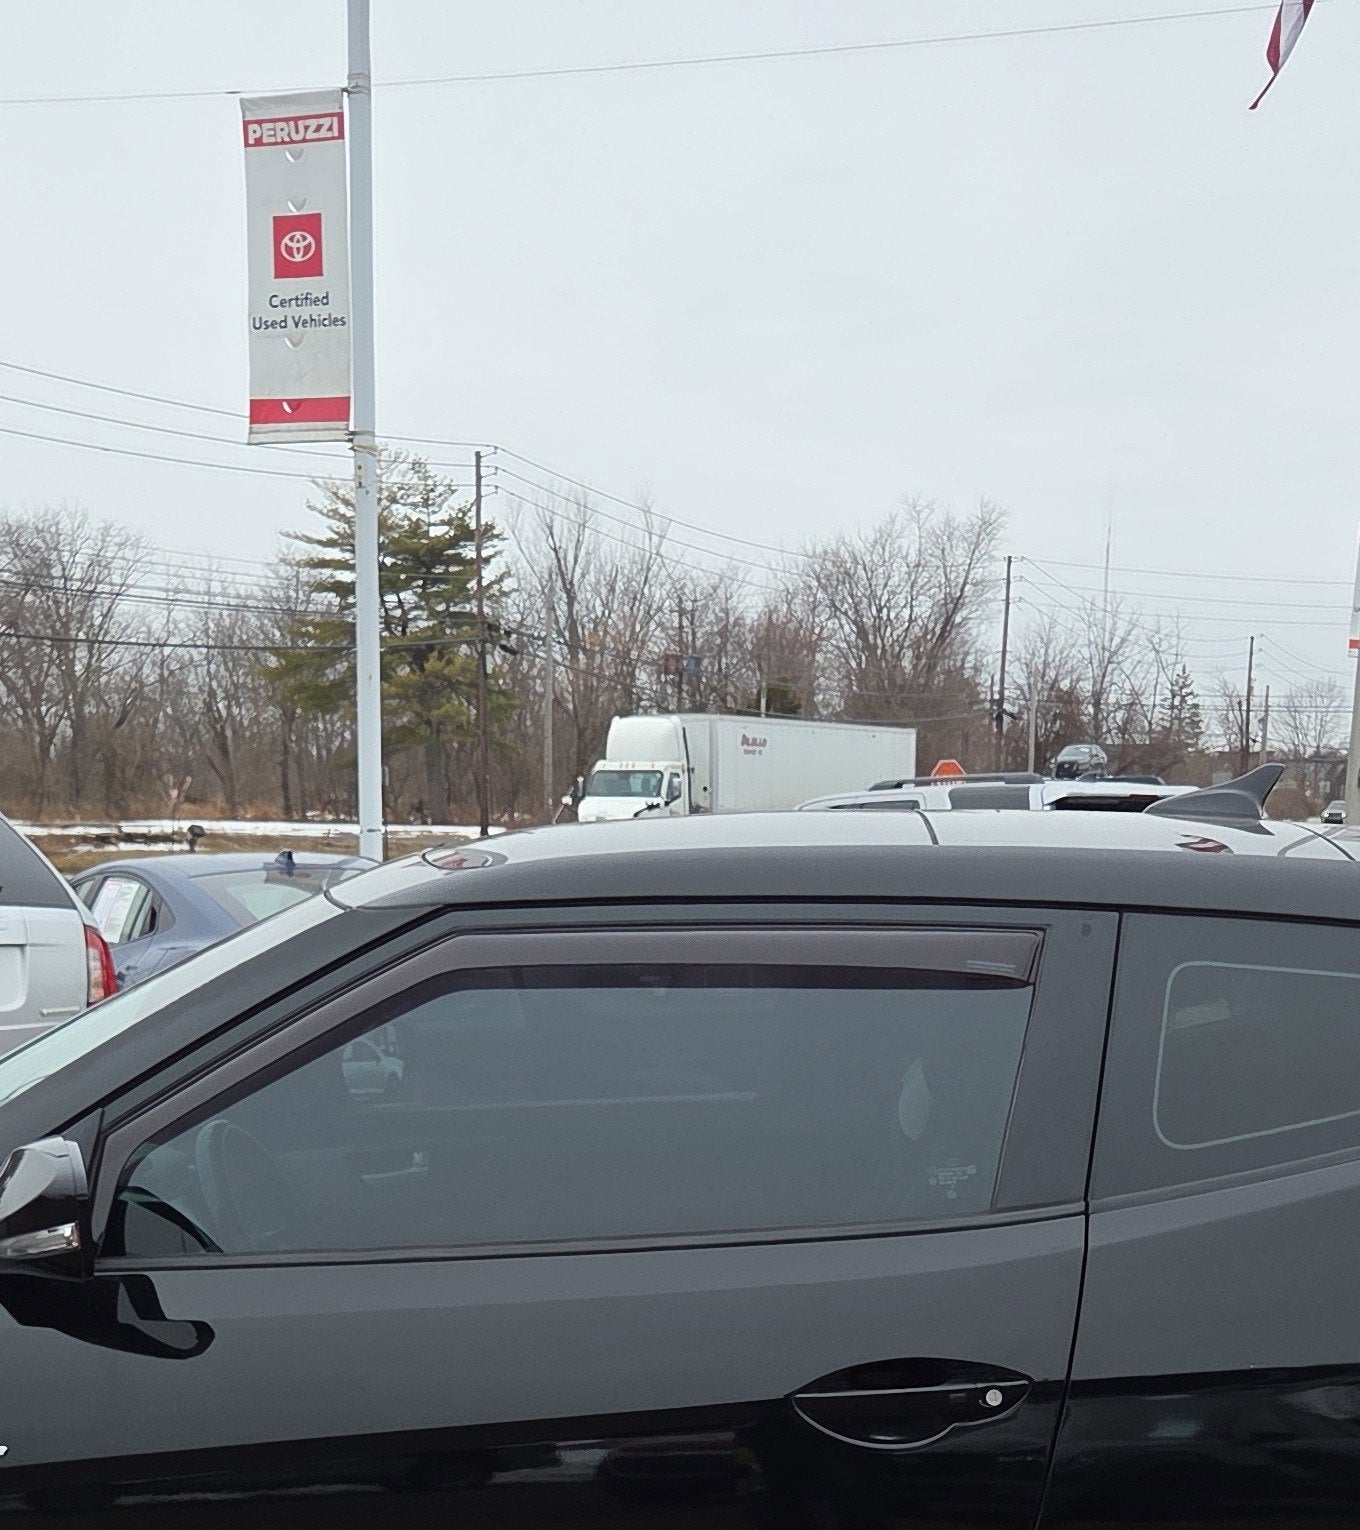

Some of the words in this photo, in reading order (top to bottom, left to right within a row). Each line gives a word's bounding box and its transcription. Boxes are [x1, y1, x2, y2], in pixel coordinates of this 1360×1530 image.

[247, 116, 339, 144] PERUZZI
[268, 291, 330, 309] Certified
[252, 315, 288, 331] Used
[291, 313, 347, 330] Vehicles
